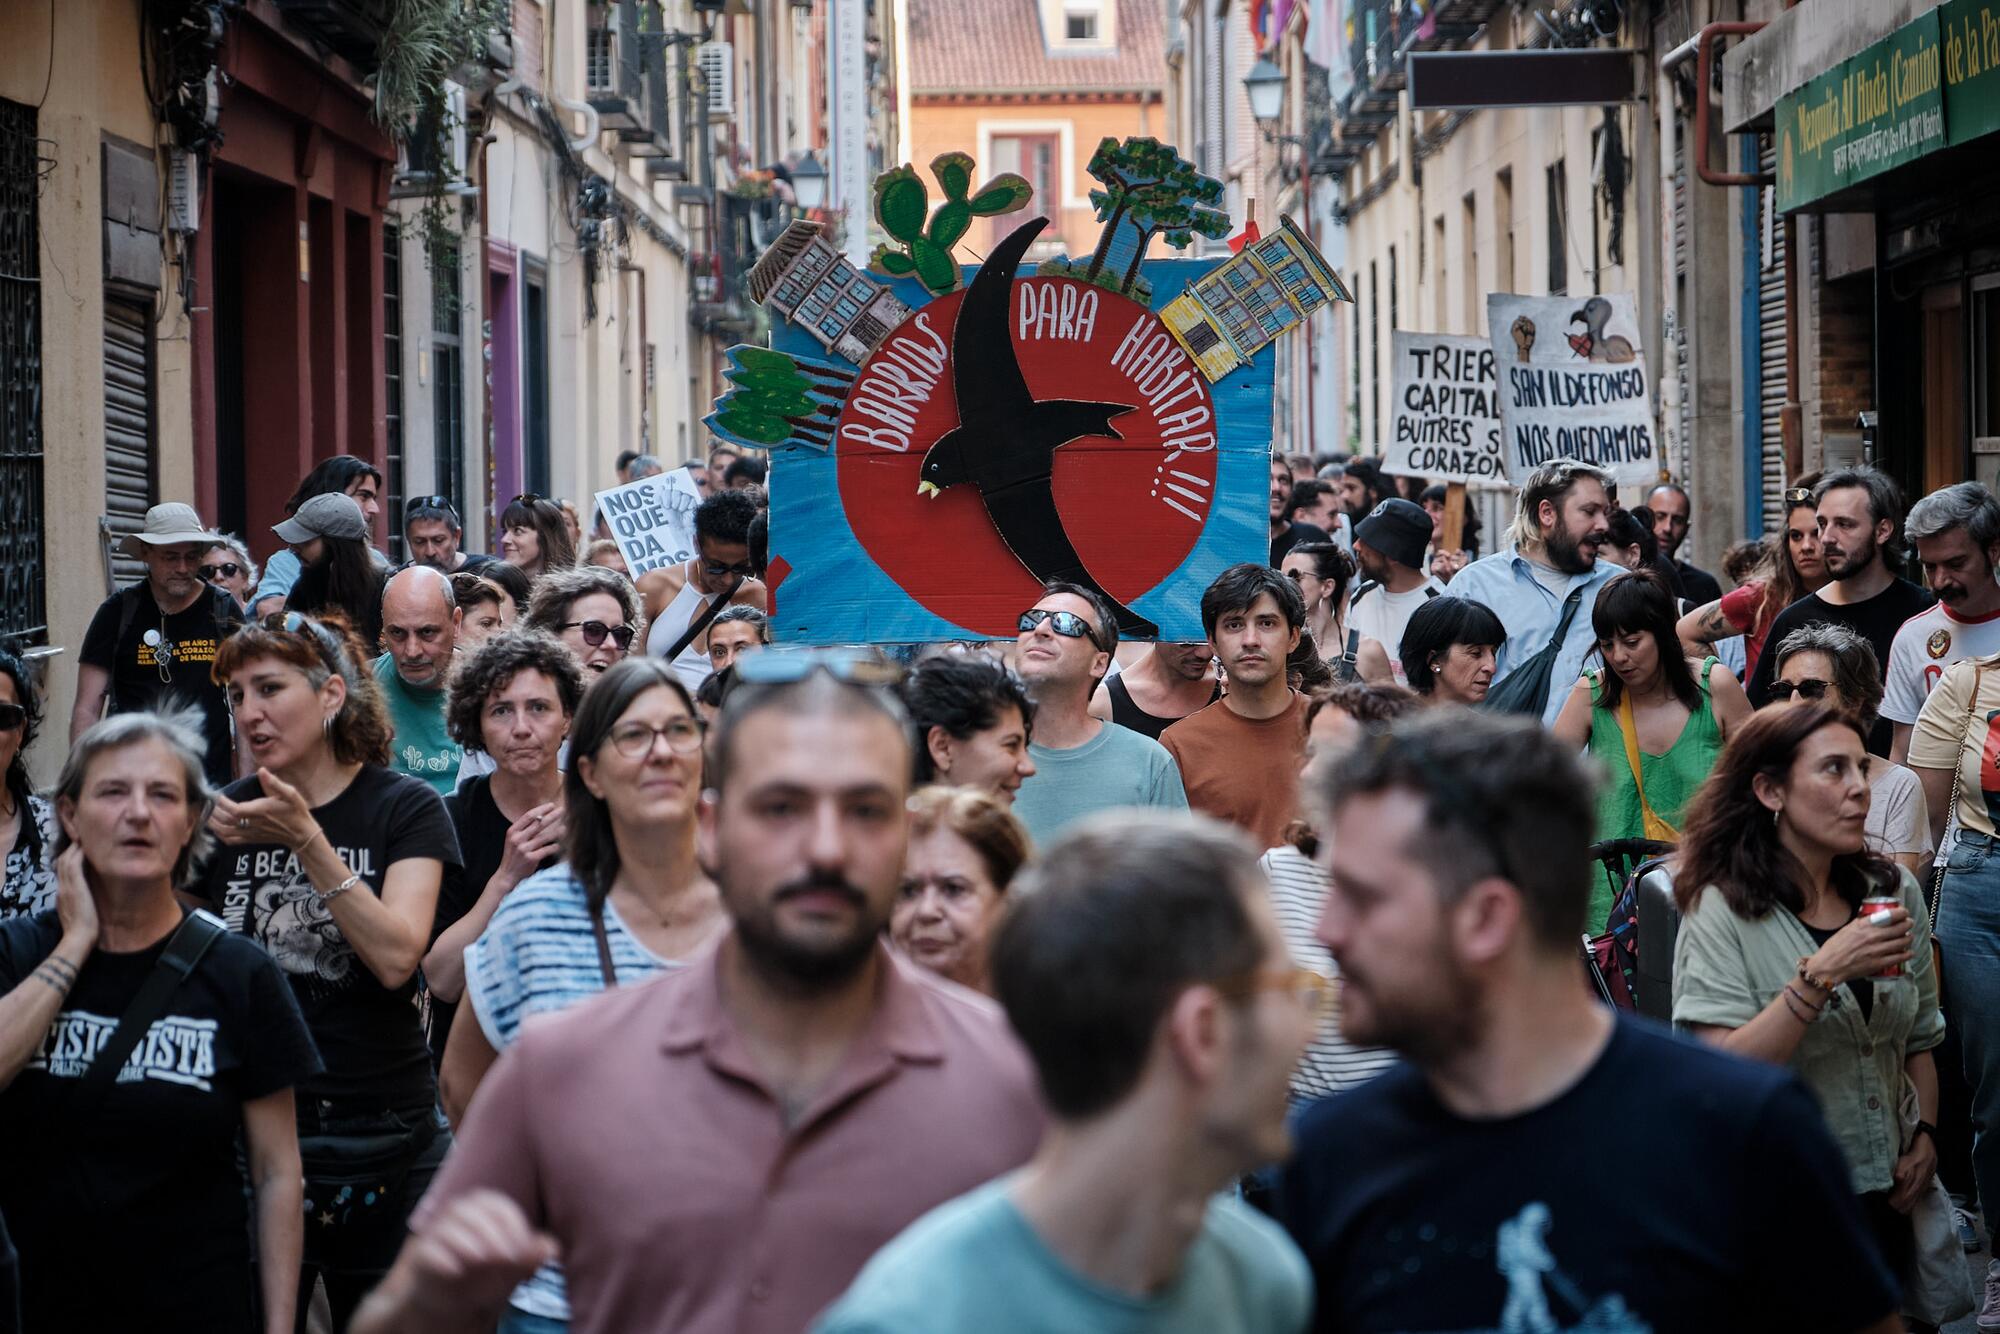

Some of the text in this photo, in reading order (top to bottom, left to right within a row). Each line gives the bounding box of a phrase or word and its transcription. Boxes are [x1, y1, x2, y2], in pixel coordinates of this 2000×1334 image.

[1797, 85, 1839, 160] Mezquita
[1841, 73, 1854, 132] Al
[1856, 59, 1889, 125] Huda
[1889, 35, 1939, 120] (Camino
[1946, 22, 1964, 85] de
[1964, 15, 1981, 78] la
[840, 312, 948, 453] BARRIOS
[1019, 281, 1100, 343] PARA
[1404, 383, 1500, 419] CAPITAL
[1510, 366, 1644, 407] SAN ILDEFONSO
[1516, 424, 1554, 467] NOS
[1556, 424, 1651, 464] QUEDAMOS
[603, 485, 655, 517] NOS
[615, 505, 669, 537] QUE
[624, 534, 665, 562] DA
[254, 847, 376, 878] BEAFUL
